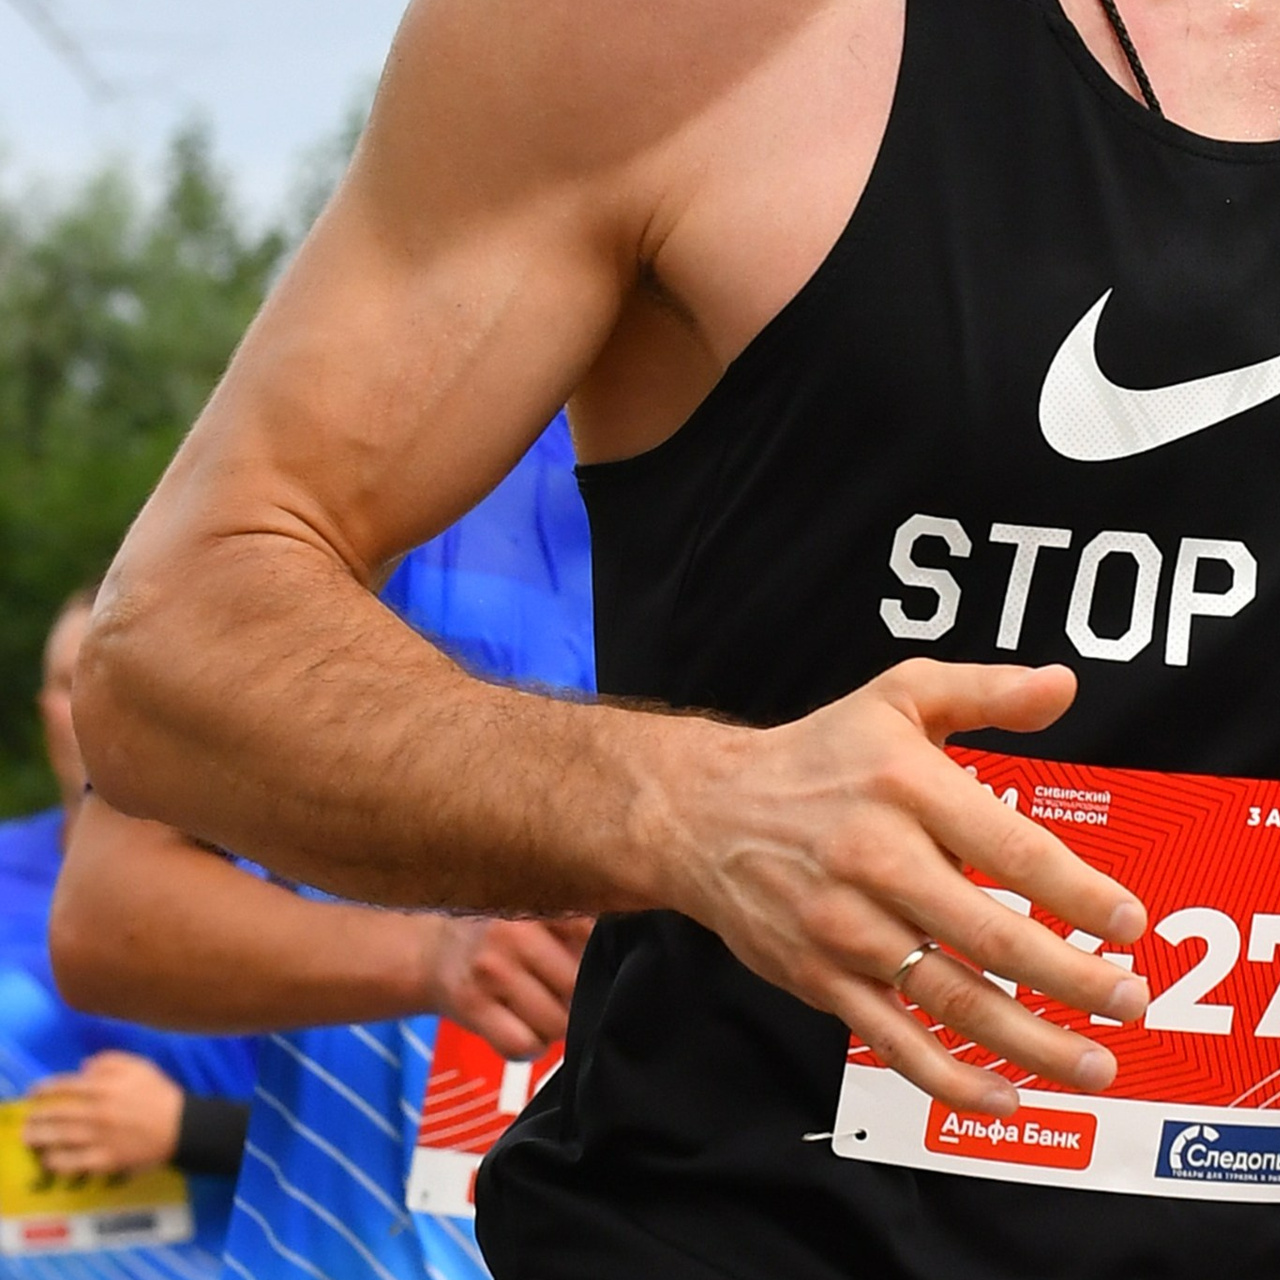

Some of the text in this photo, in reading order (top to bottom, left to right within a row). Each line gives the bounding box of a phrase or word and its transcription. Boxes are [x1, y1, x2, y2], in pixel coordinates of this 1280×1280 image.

[879, 513, 1258, 667] STOP
[1034, 785, 1111, 804] СИБИРСКИЙ
[1031, 805, 1108, 826] МАРАФОН
[1246, 806, 1261, 826] 3
[939, 1112, 1081, 1150] Альфа Банк
